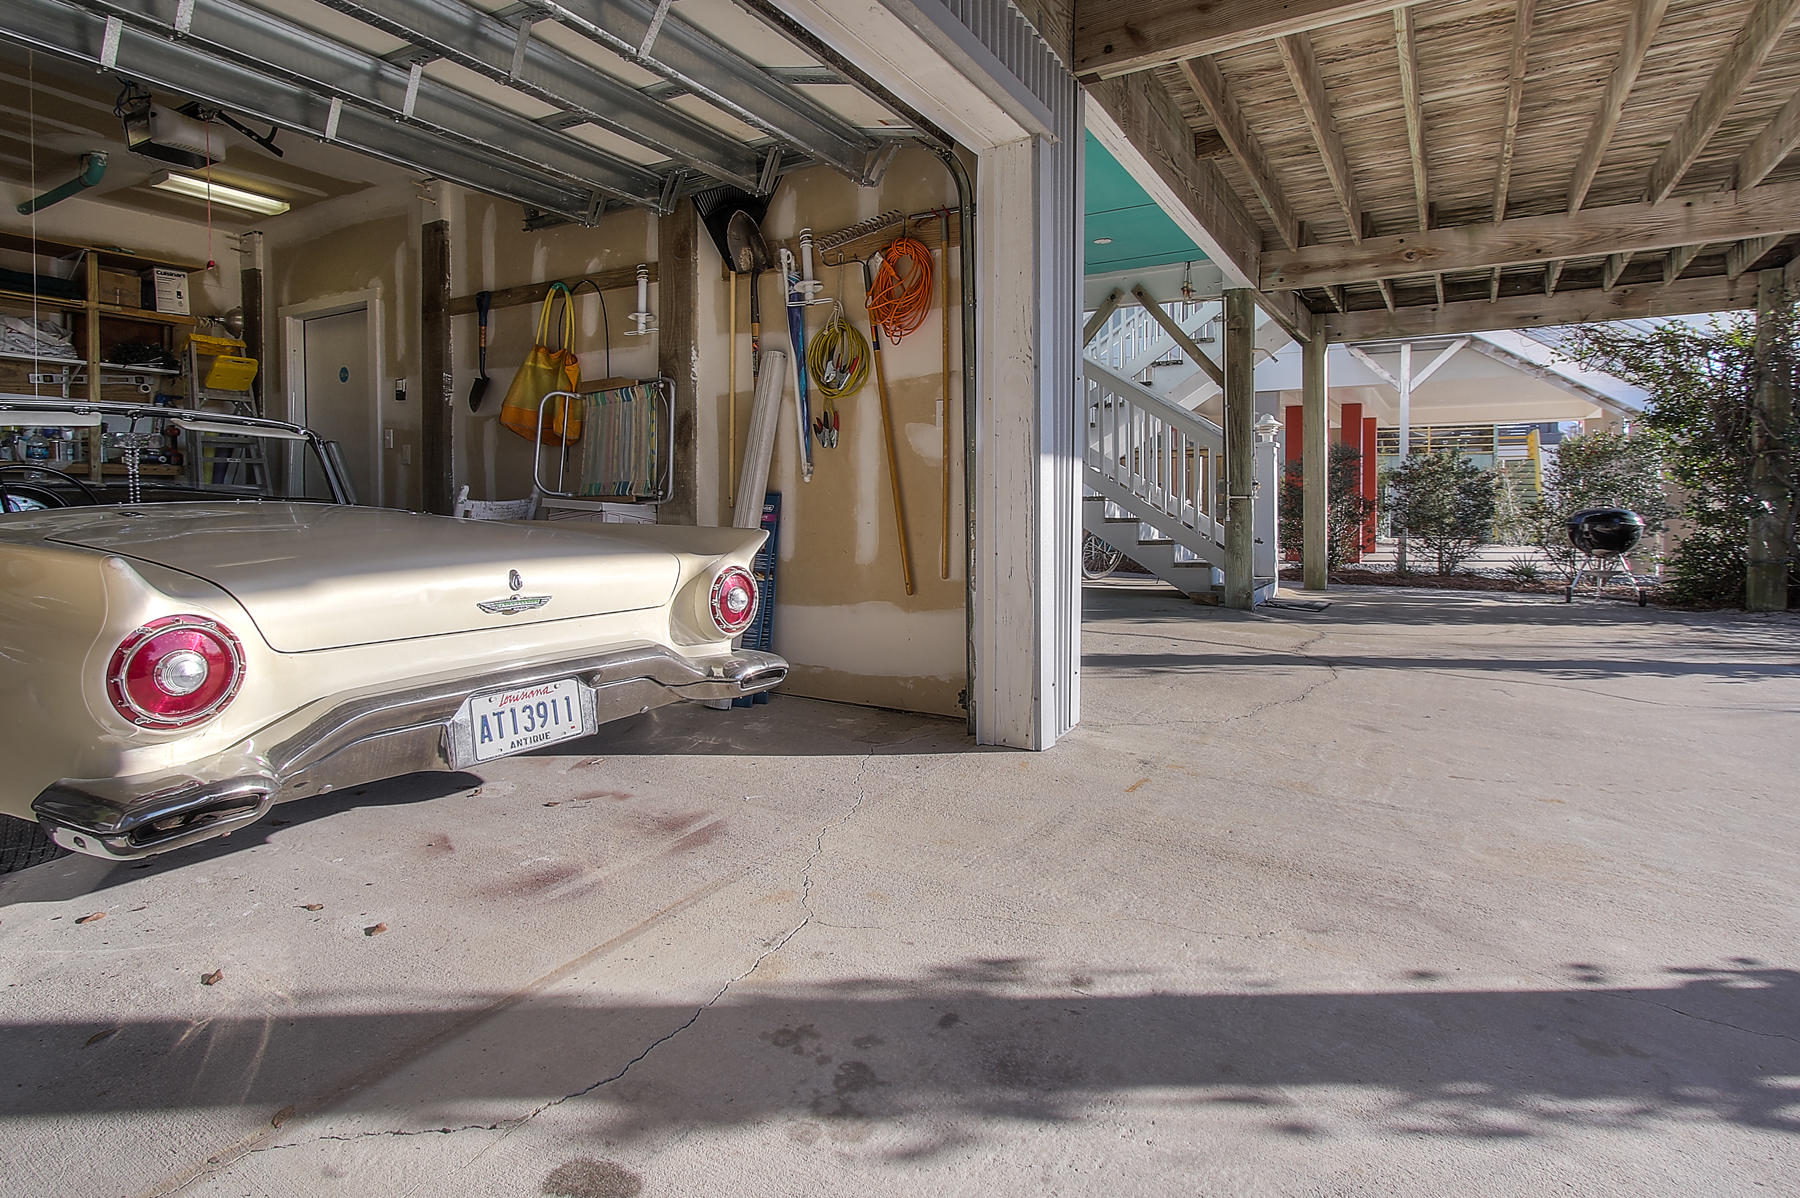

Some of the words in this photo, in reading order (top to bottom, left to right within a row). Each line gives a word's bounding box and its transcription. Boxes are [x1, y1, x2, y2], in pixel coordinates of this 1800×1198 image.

[499, 686, 554, 707] Louisiana
[480, 695, 573, 744] AT13911
[510, 731, 551, 749] ANTIQUE
